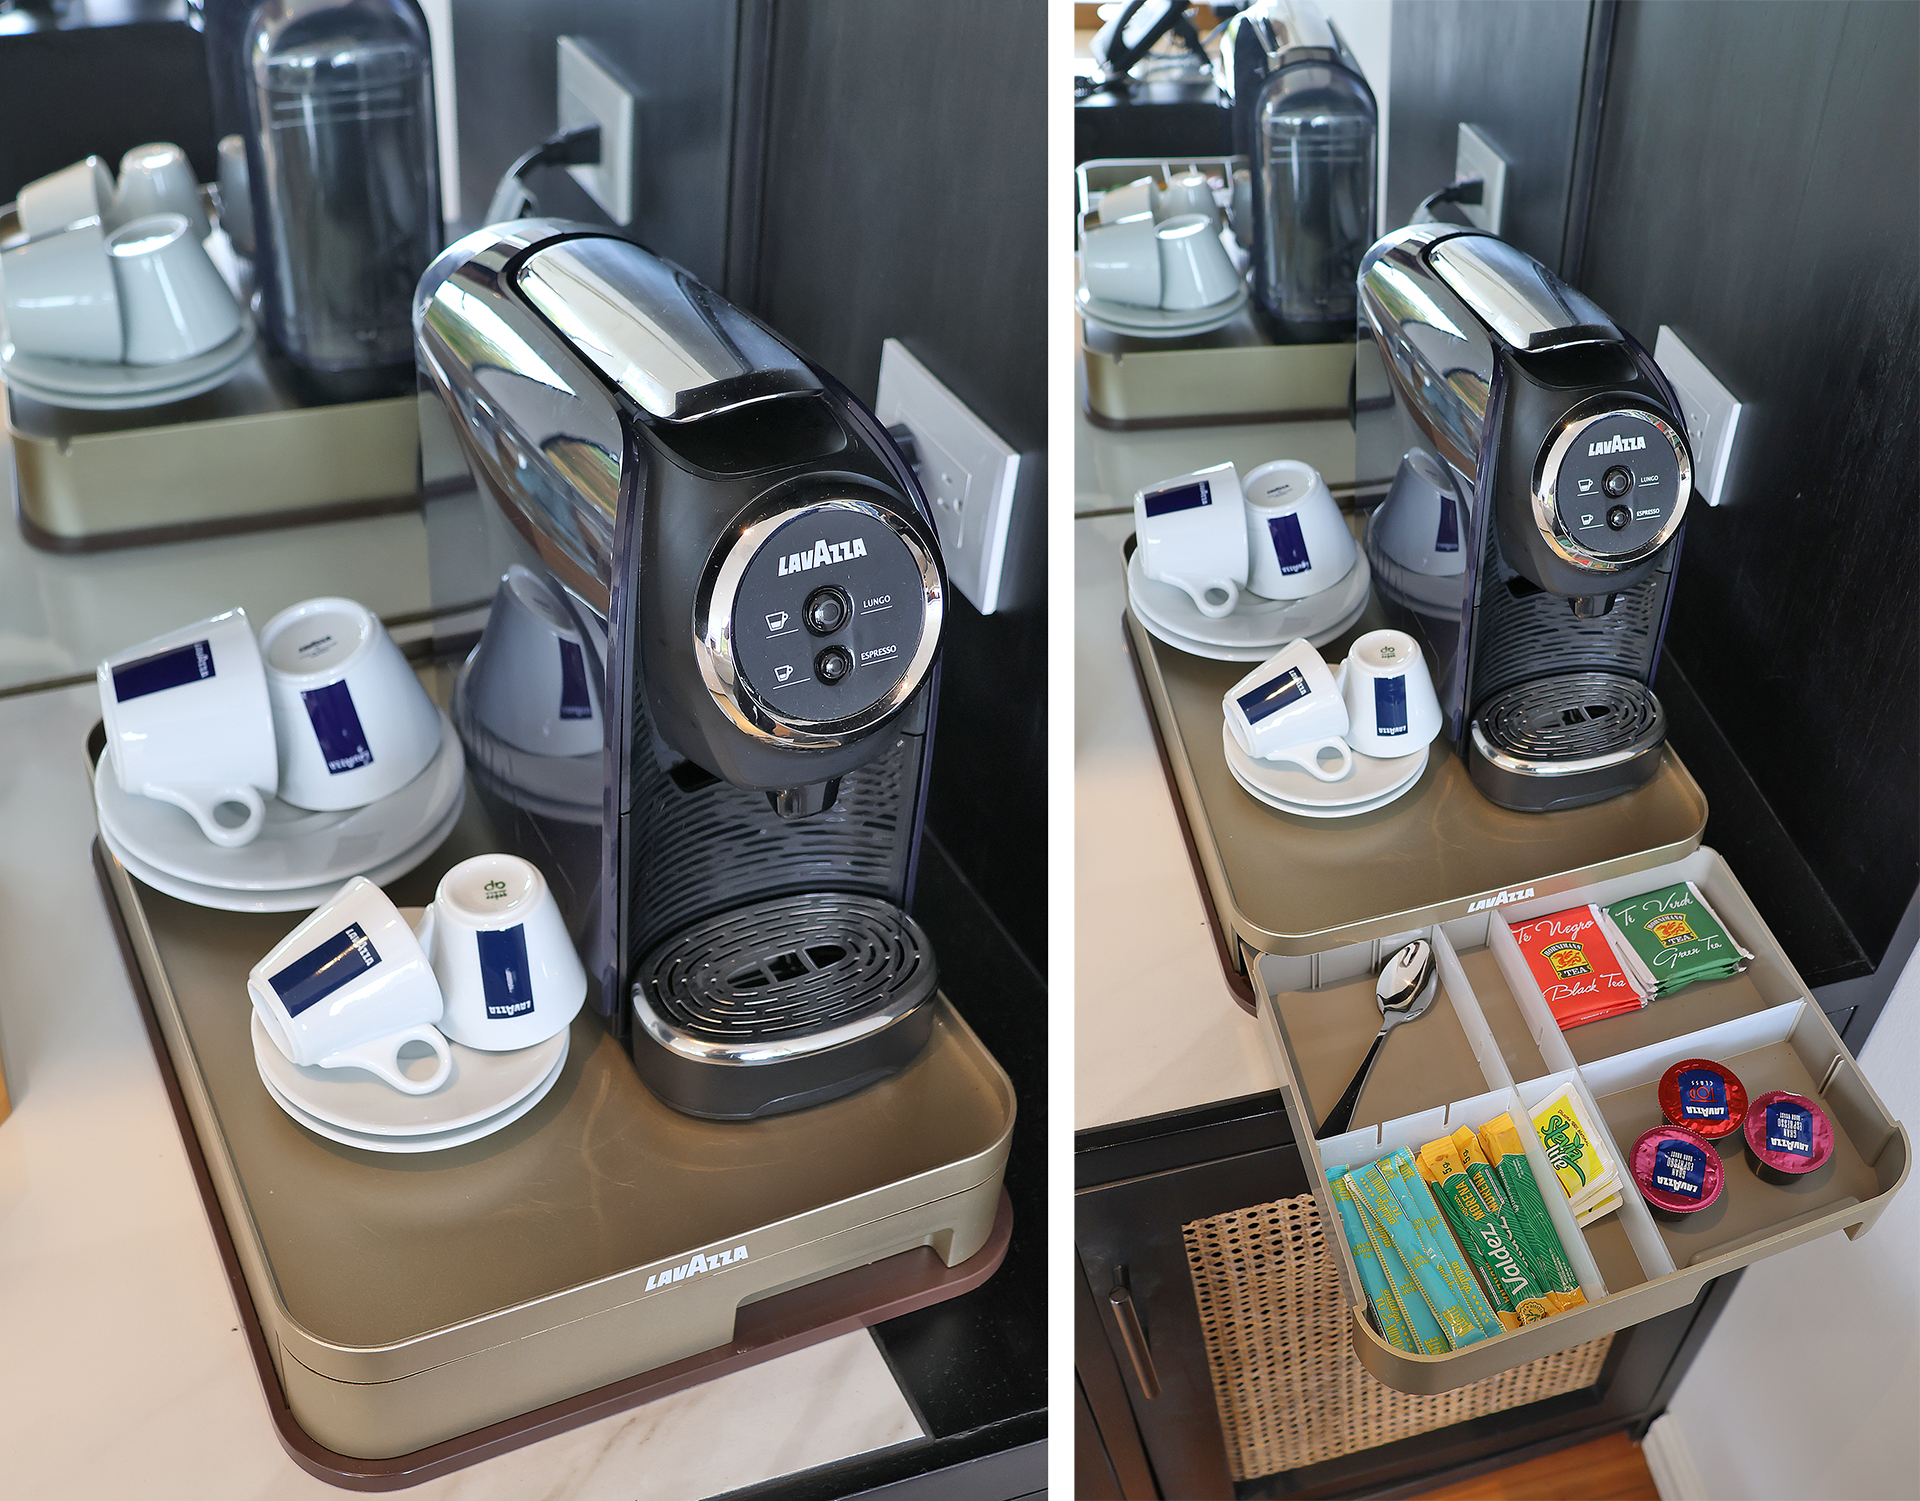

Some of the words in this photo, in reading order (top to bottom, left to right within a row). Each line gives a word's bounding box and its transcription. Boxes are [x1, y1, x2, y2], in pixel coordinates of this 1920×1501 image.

[1588, 434, 1646, 456] LAVAZZA
[1640, 475, 1659, 483] LUNGO
[1636, 508, 1660, 517] ESPRESSO
[778, 538, 868, 577] LAVAZZA
[863, 594, 891, 608] LUNGO
[861, 644, 897, 661] ESPRESSO
[1378, 725, 1407, 736] LAVAZZA
[1467, 887, 1535, 913] LAVAZZA
[1642, 892, 1693, 912] Verde
[1535, 919, 1594, 941] Negro
[344, 928, 375, 967] LAVAZZA
[1668, 935, 1692, 945] TEA
[1653, 948, 1700, 969] Green
[1698, 934, 1722, 950] Tea
[1563, 965, 1589, 977] TEA
[1542, 979, 1599, 1001] Black
[1599, 973, 1626, 988] Tea
[489, 1000, 532, 1016] LAVAZZA
[1689, 1086, 1718, 1103] TOP
[1685, 1105, 1725, 1117] LAVAZZA
[1541, 1115, 1583, 1162] Stevia
[1771, 1137, 1809, 1152] LAVAZZA
[1546, 1143, 1568, 1171] life
[1656, 1175, 1698, 1193] LAVAZZA
[1455, 1180, 1486, 1221] MORENA
[1391, 1205, 1402, 1217] TU
[644, 1245, 749, 1292] LAVAZZA
[1480, 1222, 1529, 1296] Valdez
[1375, 1296, 1386, 1311] TU
[1384, 1289, 1401, 1324] endulza
